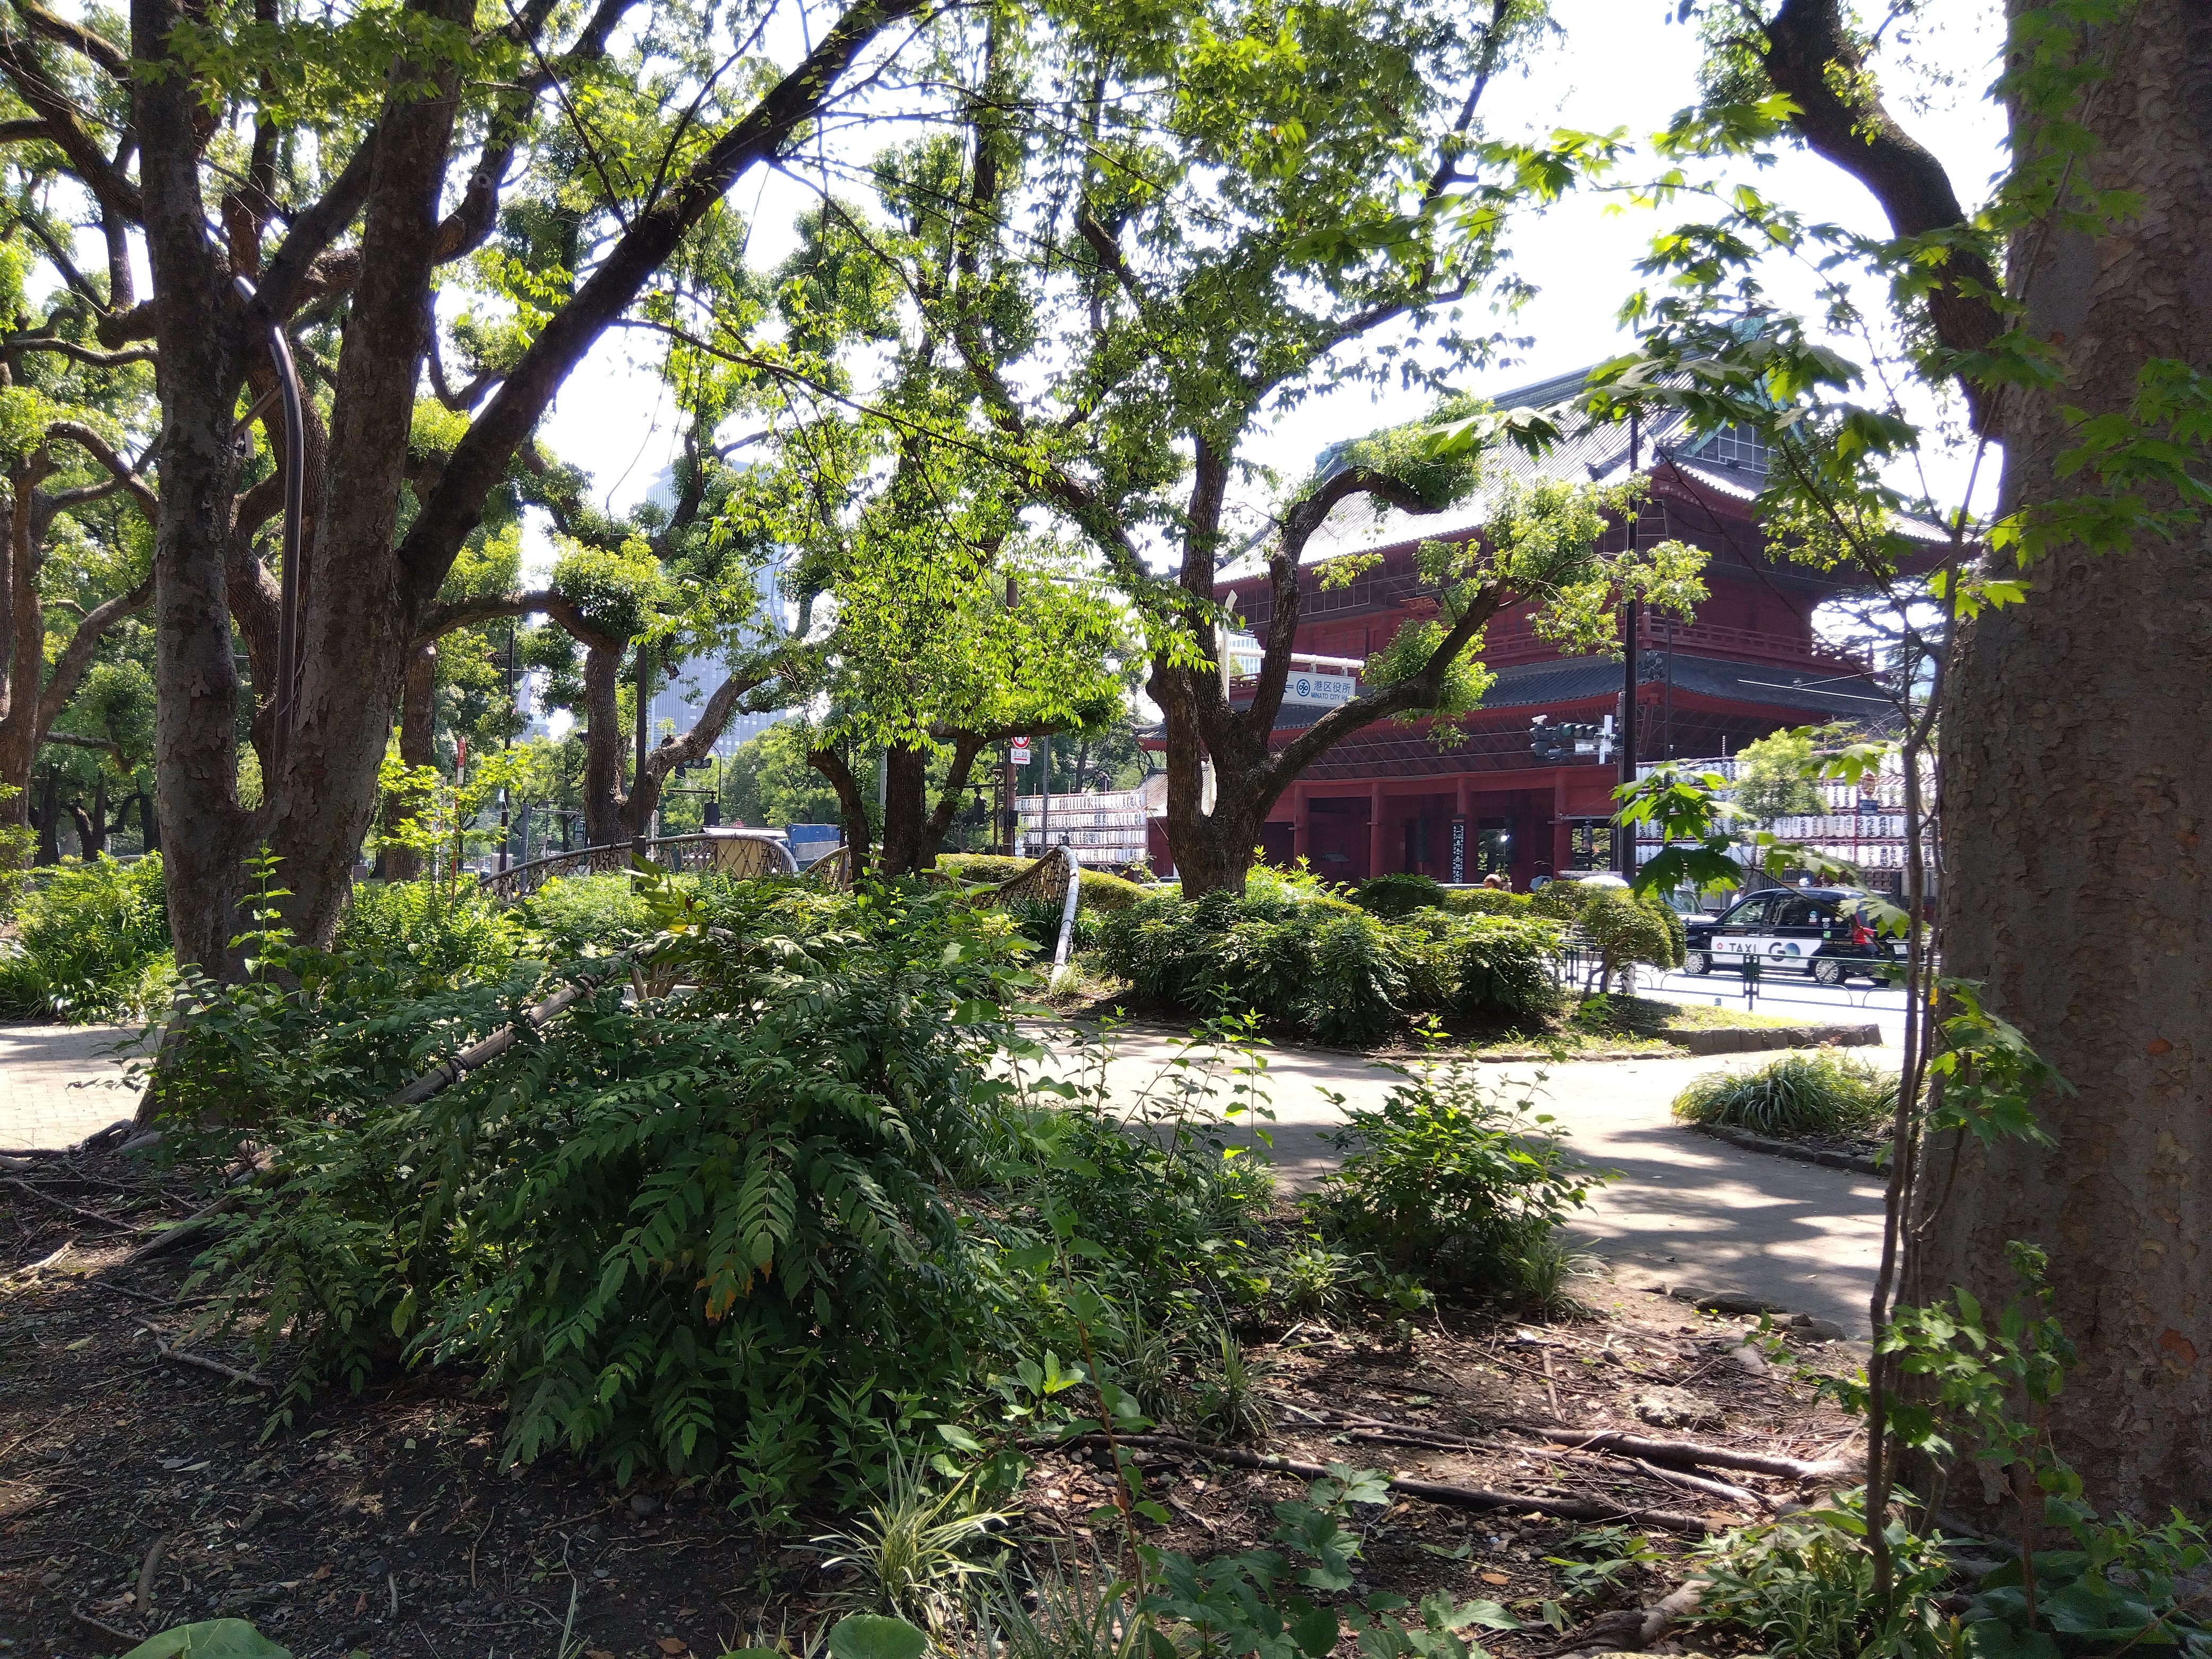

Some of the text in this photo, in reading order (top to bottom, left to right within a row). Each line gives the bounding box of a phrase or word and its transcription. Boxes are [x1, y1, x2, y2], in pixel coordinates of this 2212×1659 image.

[1313, 680, 1351, 694] 港区役所
[1729, 942, 1801, 963] TAXI GO
